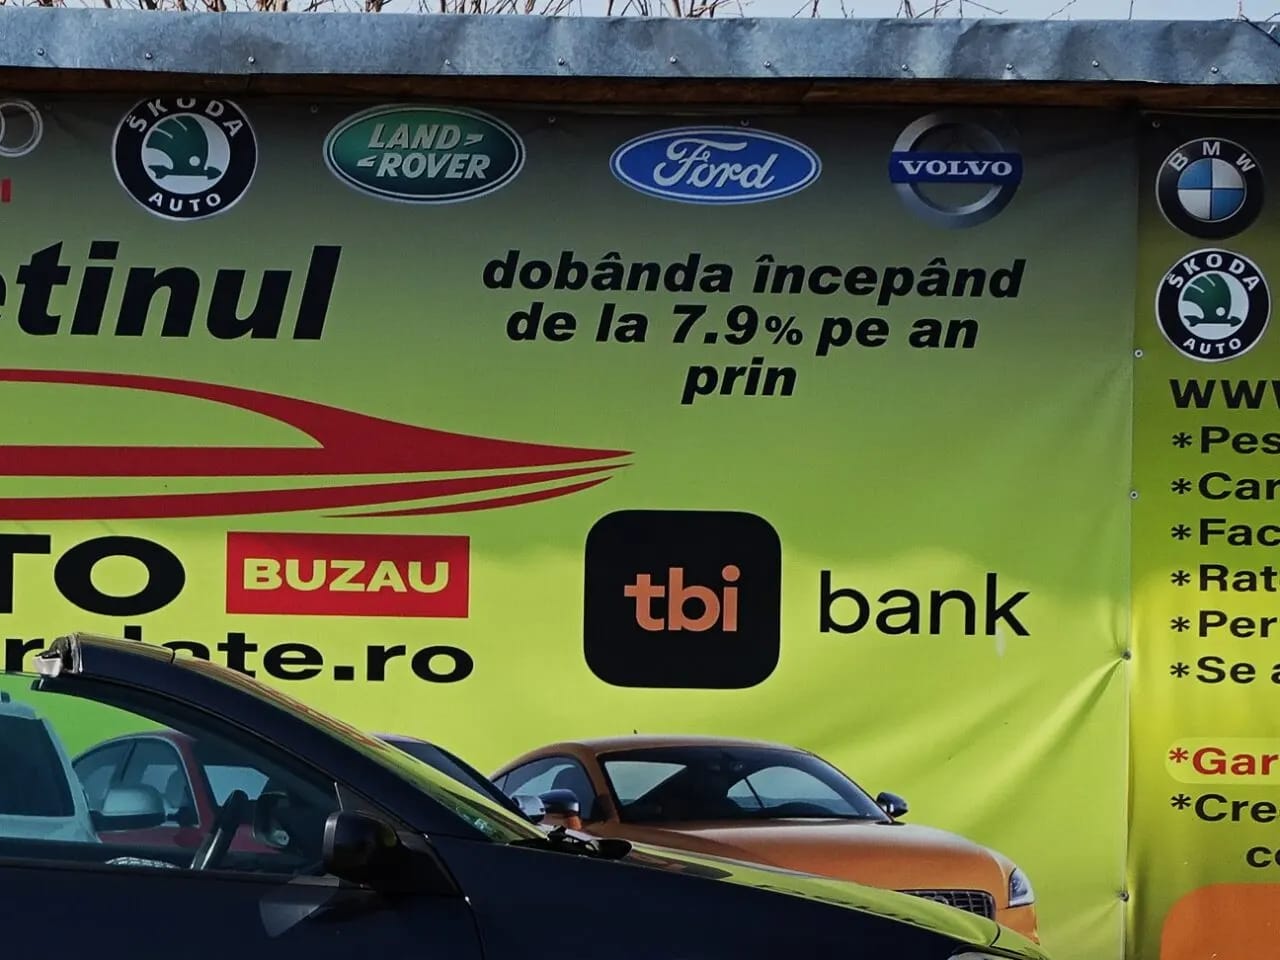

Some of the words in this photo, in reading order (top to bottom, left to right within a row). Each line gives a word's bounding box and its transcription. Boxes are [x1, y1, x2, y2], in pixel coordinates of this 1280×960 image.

[368, 123, 461, 150] LAND
[375, 153, 491, 180] ROVER
[653, 137, 778, 189] Ford
[898, 159, 1013, 178] VOLVO
[148, 192, 222, 213] AUTO
[482, 250, 732, 293] dobânda
[752, 254, 1026, 305] începând
[505, 302, 577, 343] de
[595, 303, 648, 343] la
[816, 315, 889, 356] pe
[909, 317, 979, 349] an
[1183, 338, 1242, 355] AUTO
[681, 356, 798, 404] prin
[1169, 379, 1280, 409] ww
[243, 557, 450, 593] BUZAU
[1171, 564, 1280, 592] Rat
[624, 565, 742, 632] tbi
[819, 570, 1031, 636] bank
[1171, 794, 1280, 823] Cre
